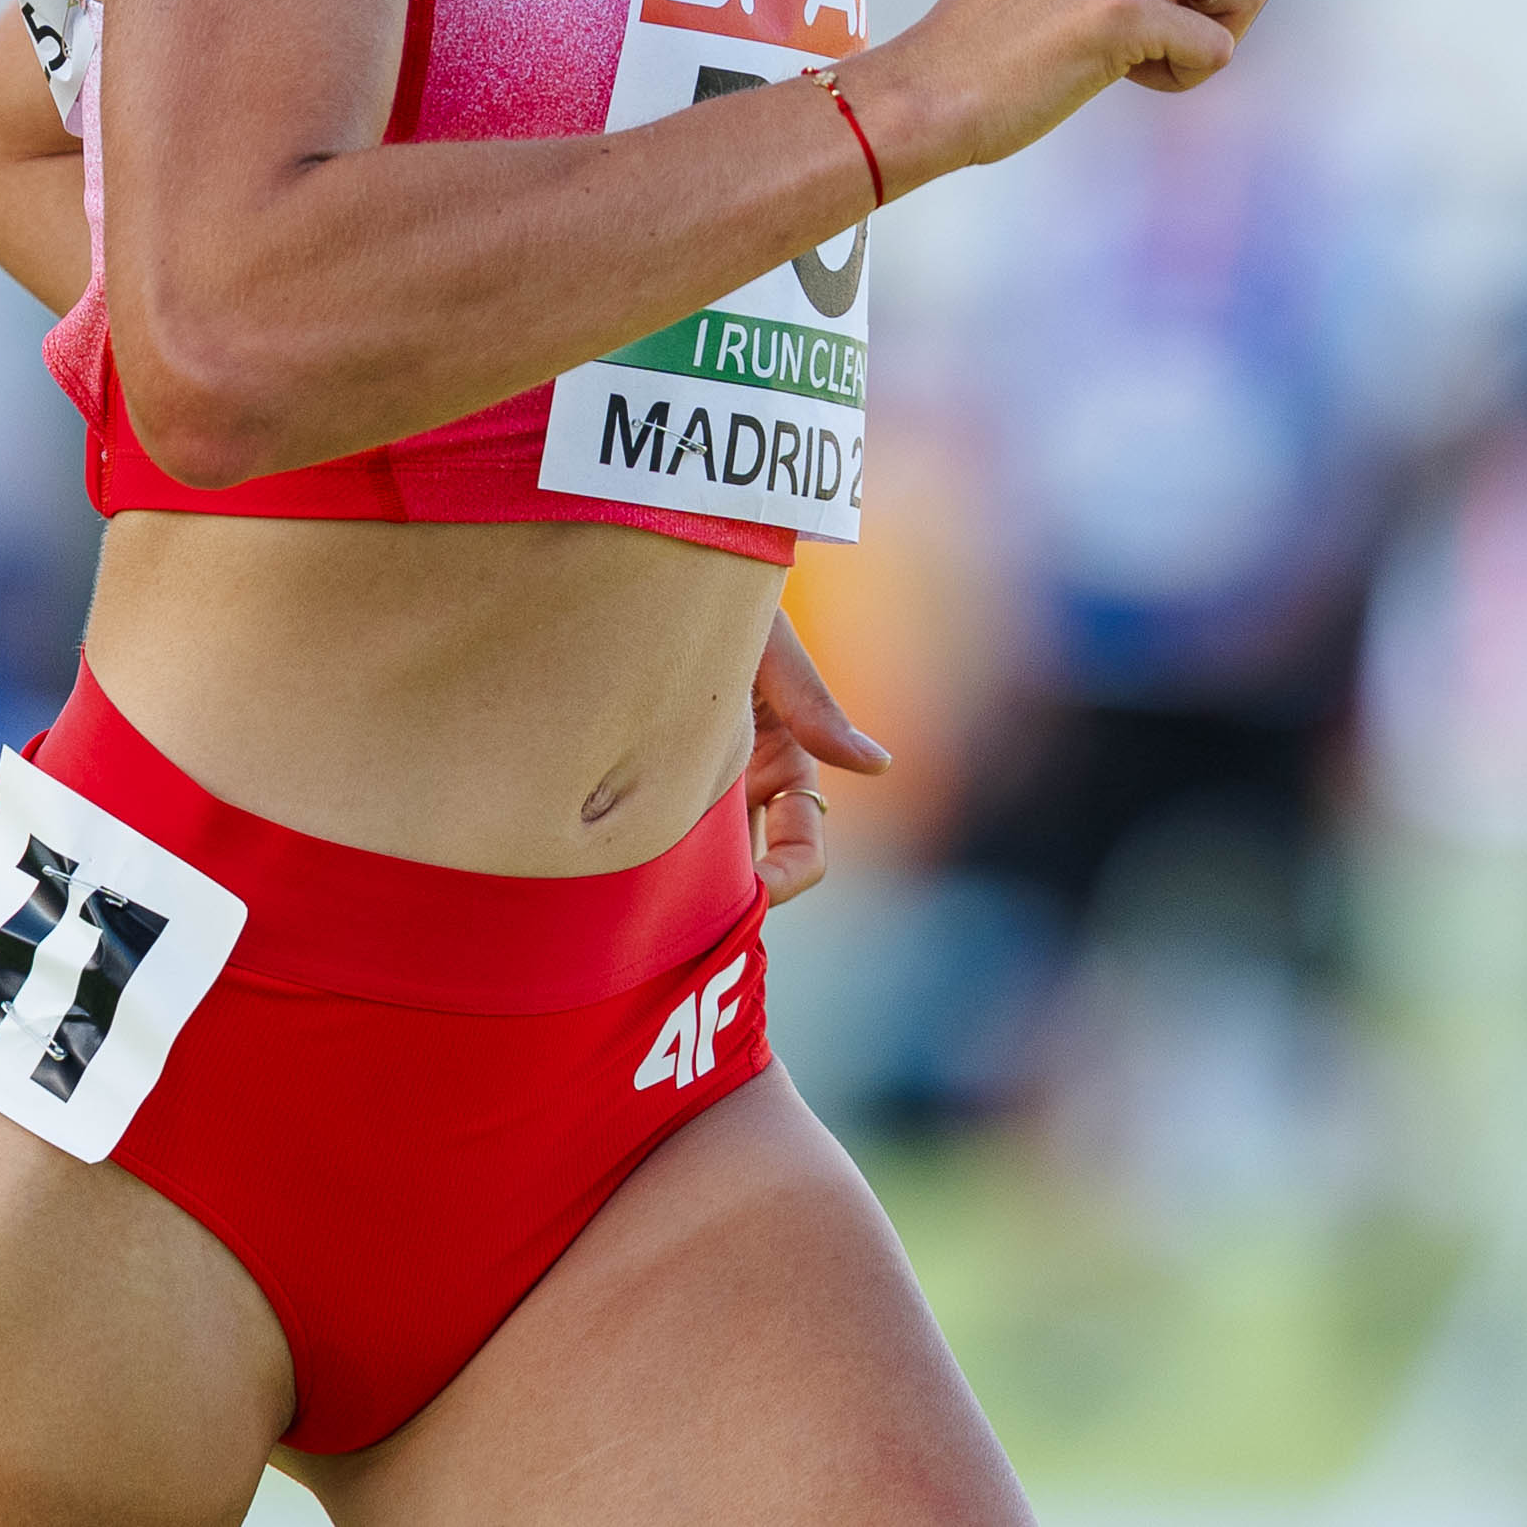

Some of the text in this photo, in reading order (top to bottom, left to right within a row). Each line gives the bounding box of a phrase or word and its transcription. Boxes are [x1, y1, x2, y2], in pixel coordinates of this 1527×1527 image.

[692, 317, 868, 400] I RUN CLEA
[599, 393, 842, 502] MADRID
[633, 952, 747, 1091] 4F
